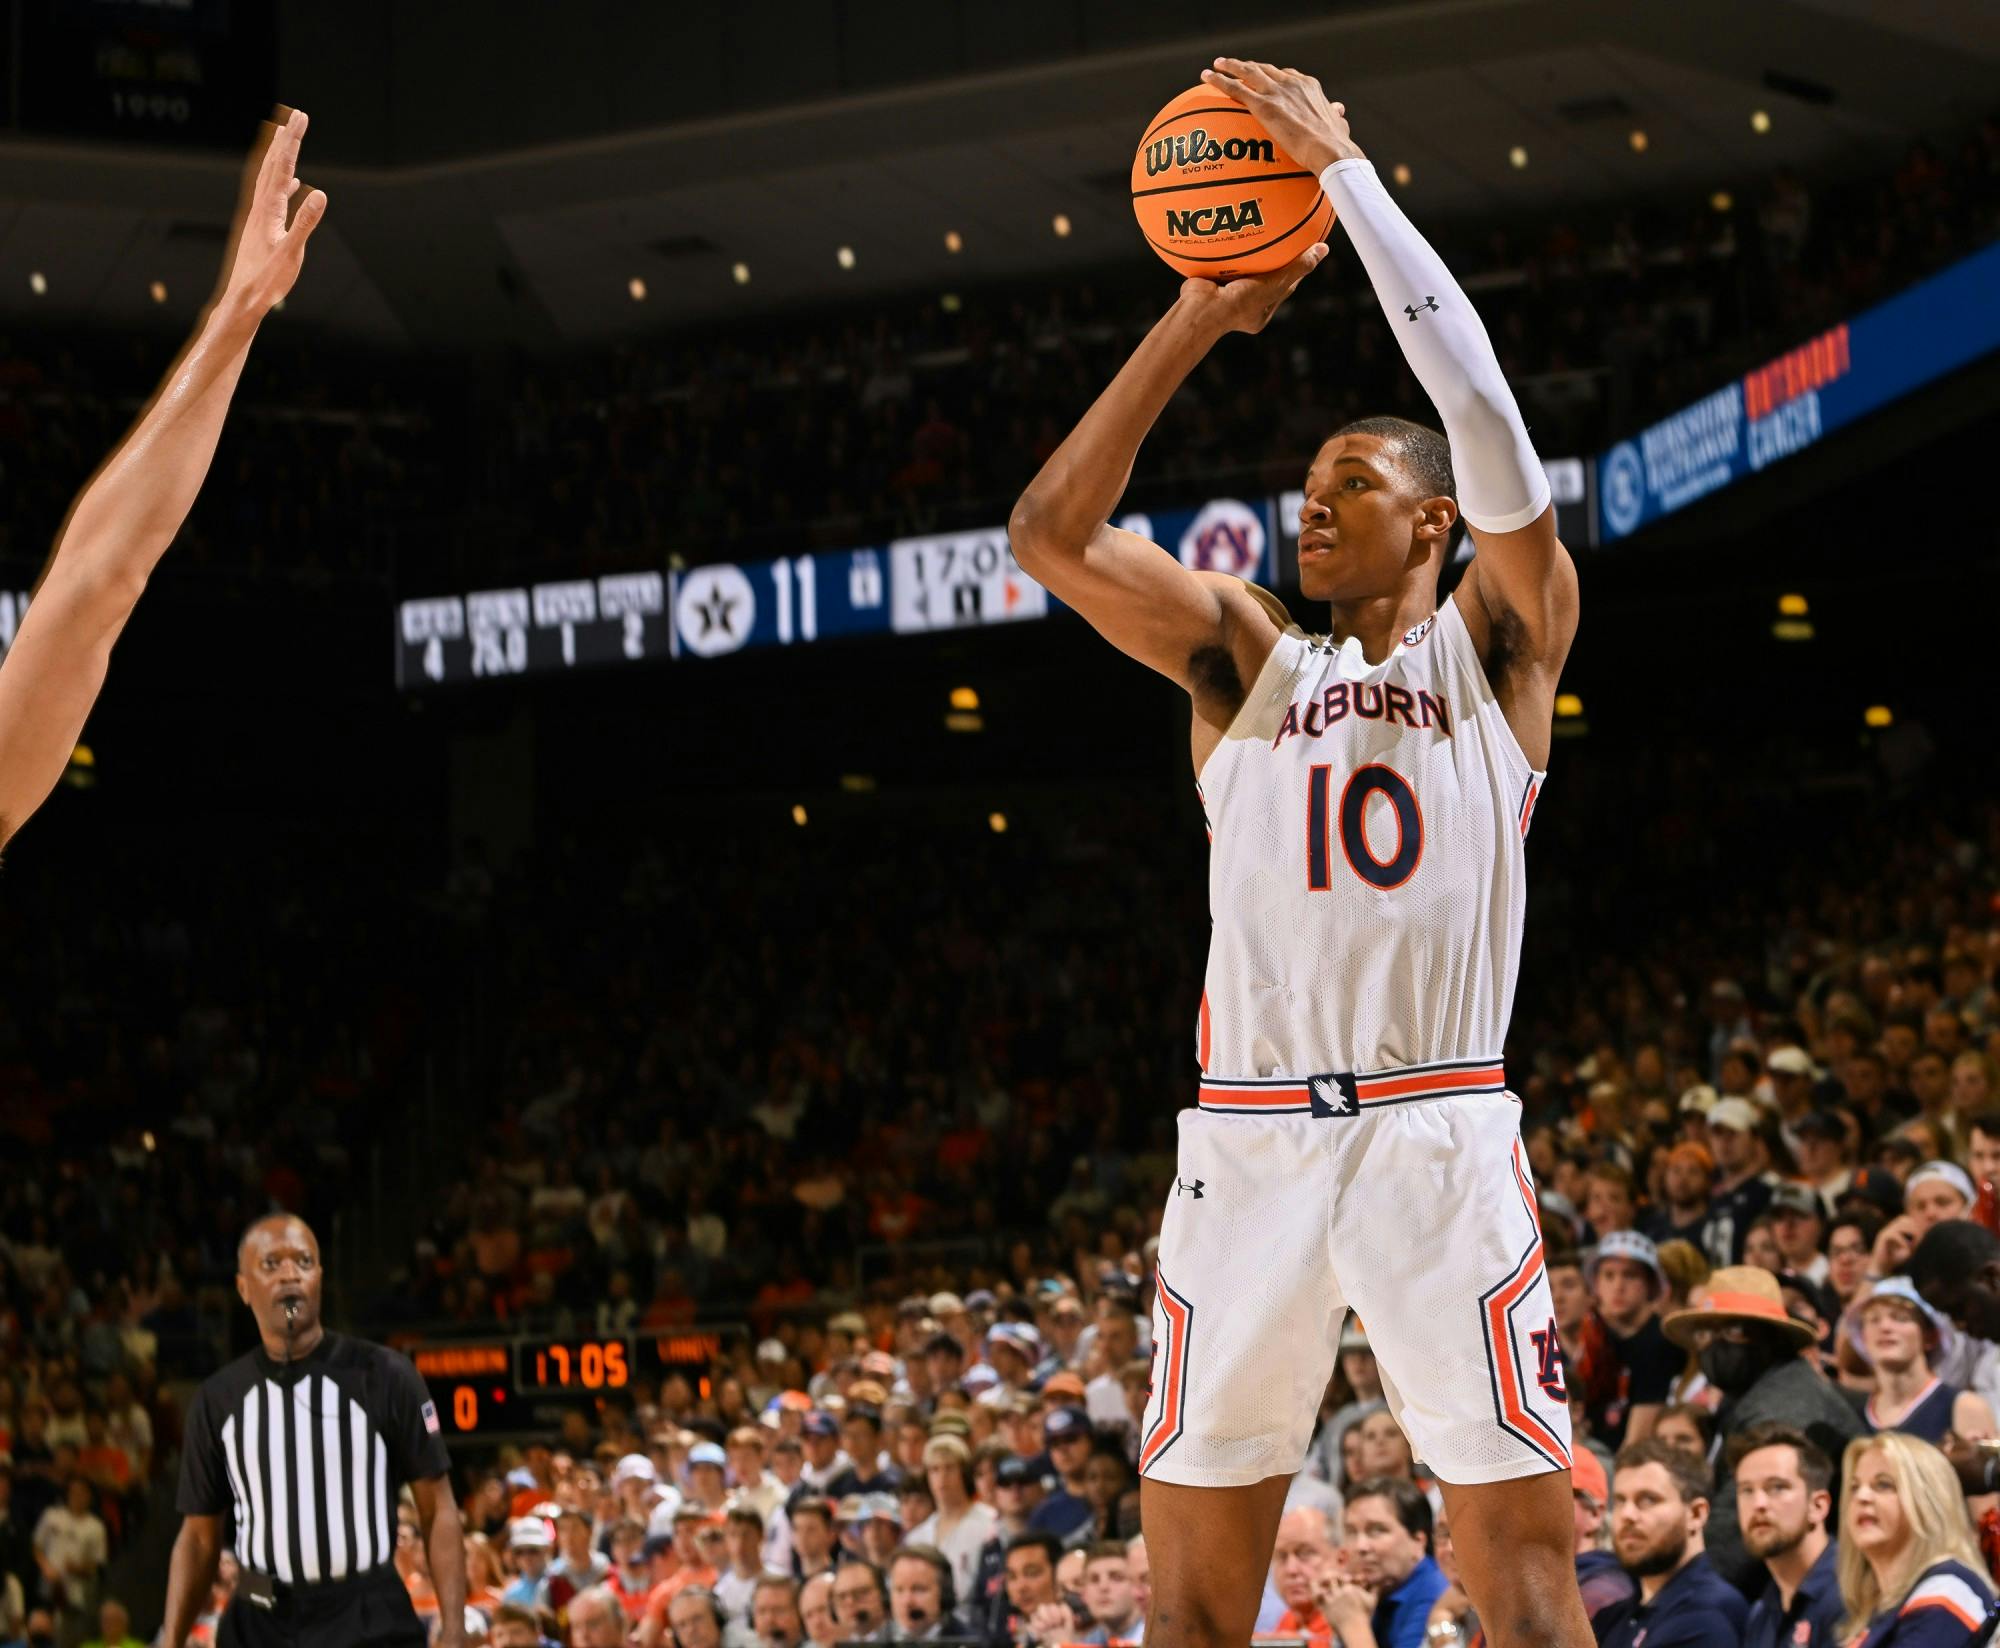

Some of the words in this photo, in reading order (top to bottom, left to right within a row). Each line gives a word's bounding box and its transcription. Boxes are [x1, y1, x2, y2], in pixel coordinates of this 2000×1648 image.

[1145, 128, 1276, 177] Wilson
[1182, 167, 1200, 175] EVO
[1204, 163, 1224, 172] NXT
[1166, 199, 1264, 237] NCAA
[1207, 235, 1236, 243] GAME
[1238, 230, 1265, 239] BALL
[771, 554, 817, 643] 11
[1272, 680, 1455, 751] AUBURN
[1306, 762, 1425, 892] 10
[453, 1384, 478, 1431] 0
